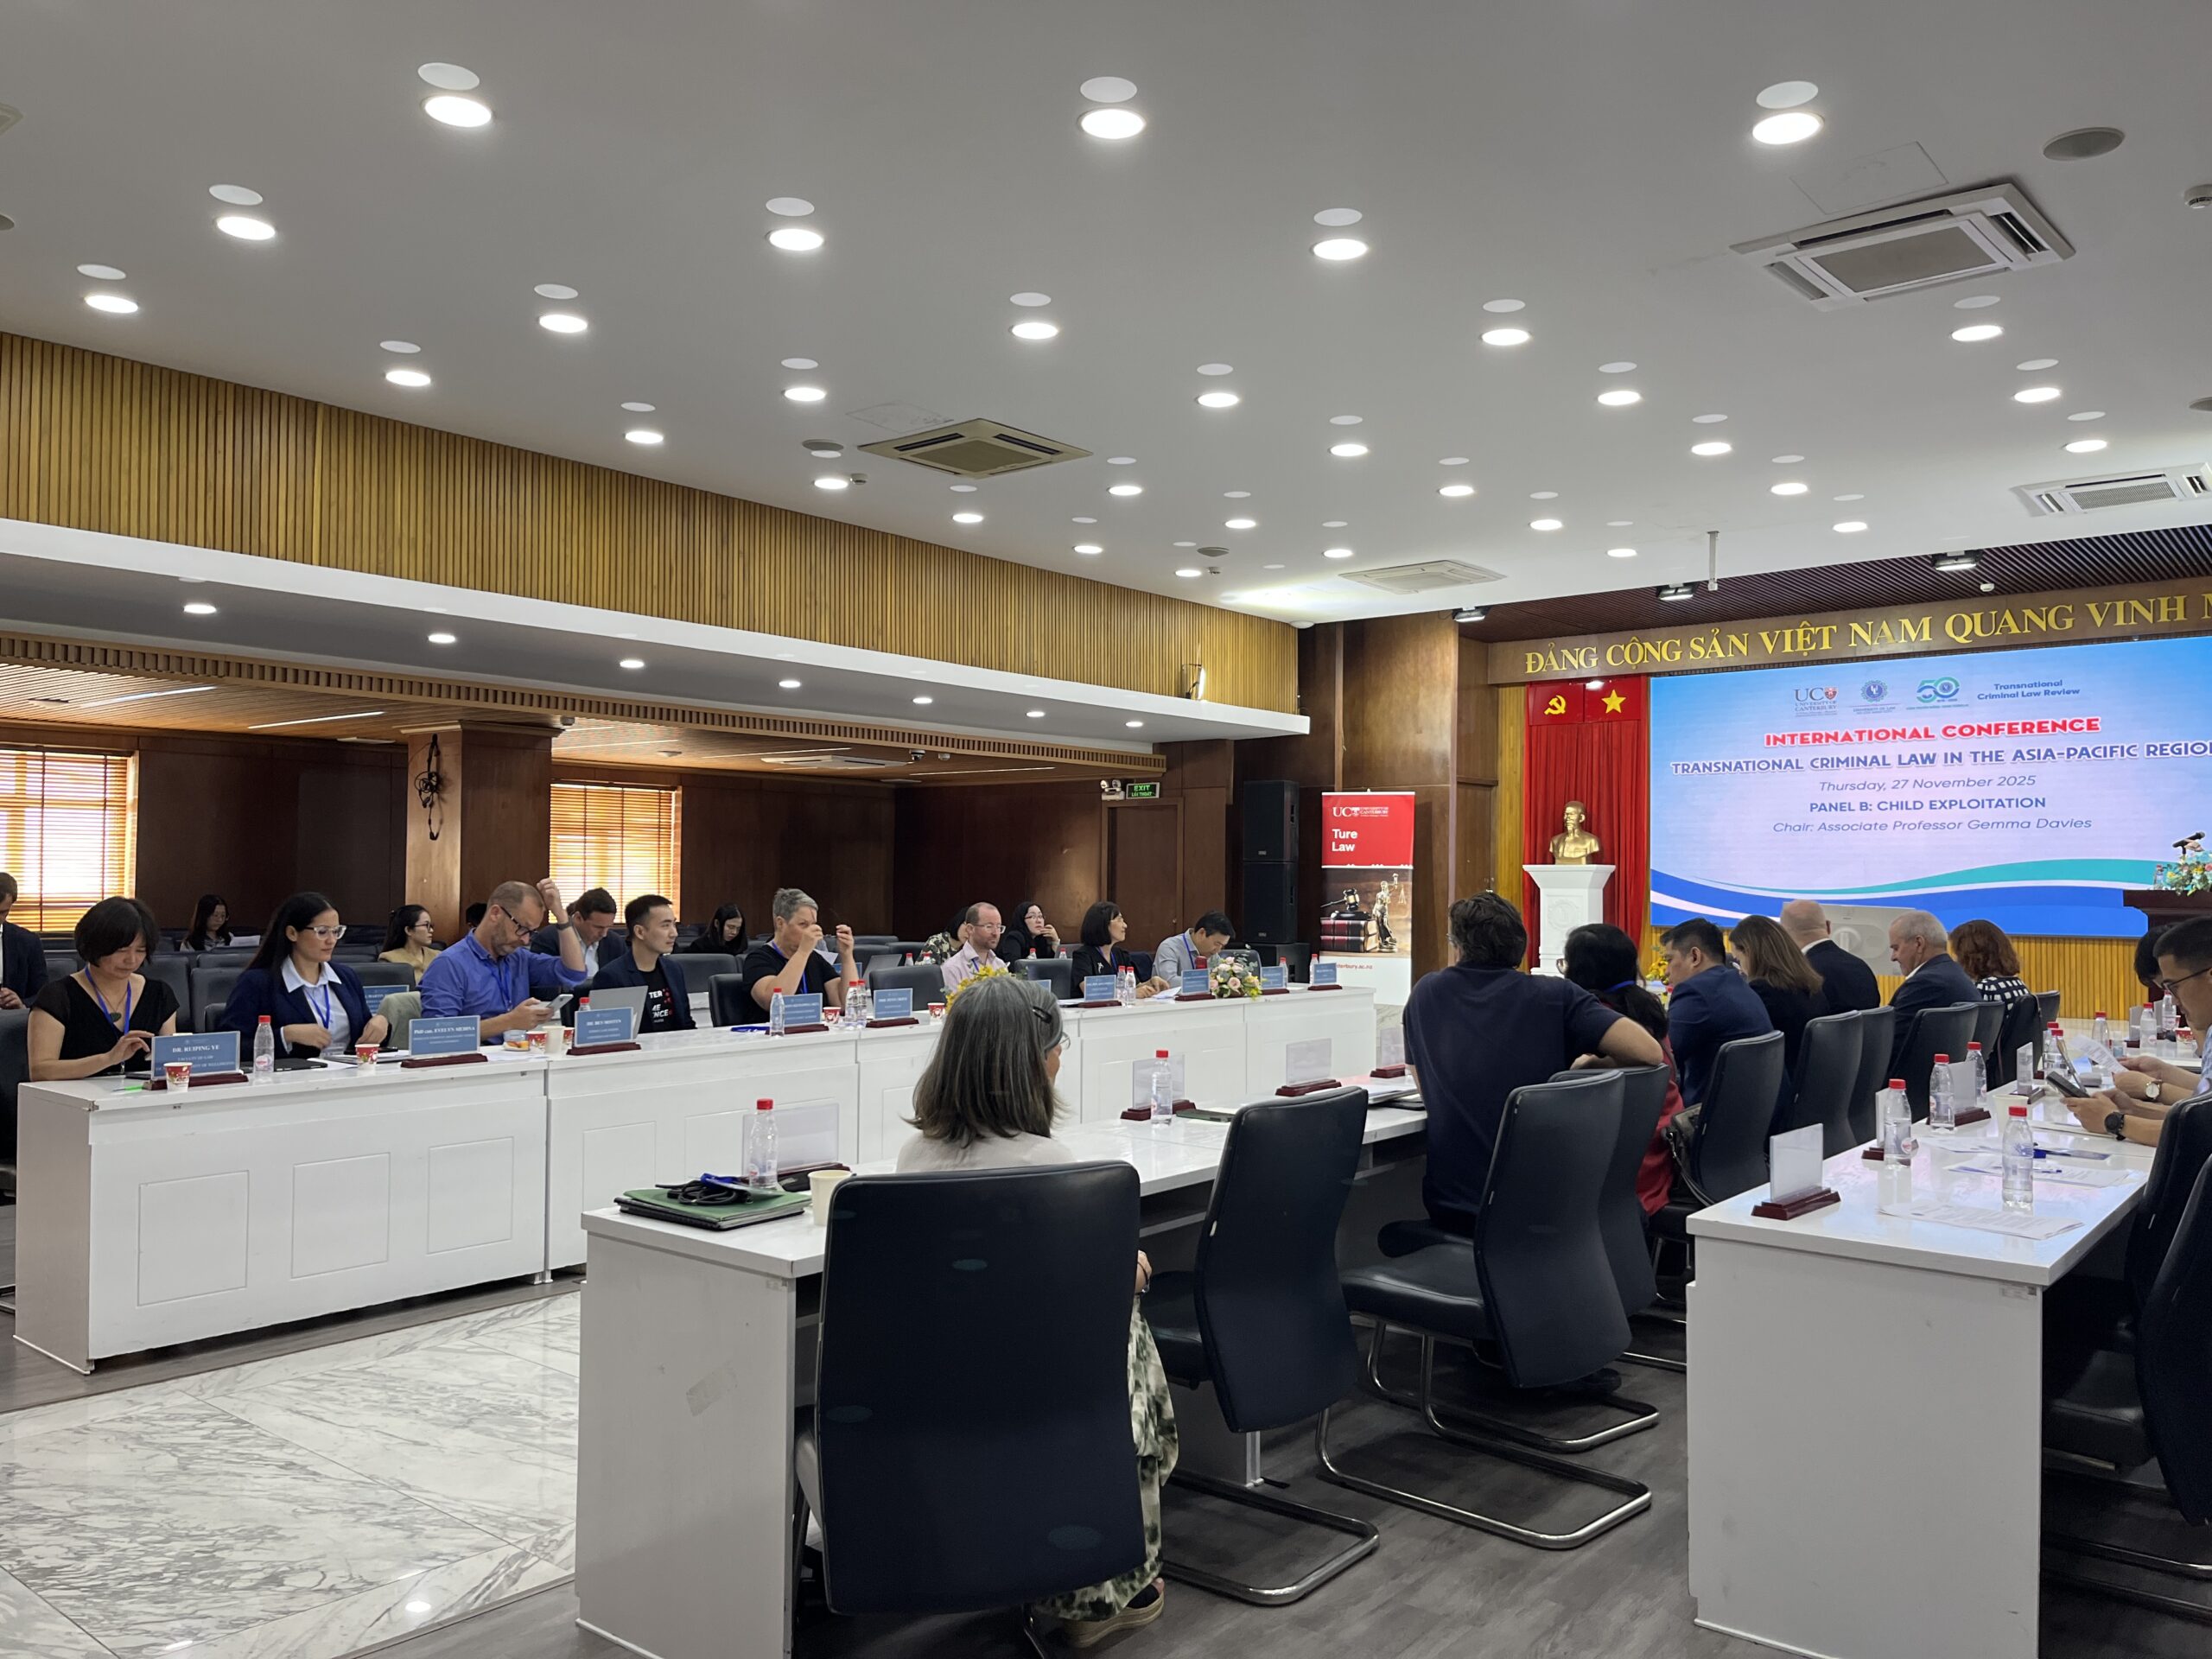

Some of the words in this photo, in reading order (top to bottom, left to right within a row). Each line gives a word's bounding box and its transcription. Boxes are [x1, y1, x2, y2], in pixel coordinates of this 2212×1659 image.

[1525, 643, 1599, 674] ĐẢNG
[1605, 636, 1682, 670] CỘNG
[1689, 627, 1750, 660] SẢN
[1758, 620, 1837, 657] VIỆT
[1847, 616, 1933, 647] NAM
[1944, 604, 2075, 644] QUANG
[2085, 595, 2189, 628] VINH
[1993, 680, 2063, 690] Transnational
[1793, 687, 1824, 702] UC
[1977, 691, 2018, 700] Criminal
[1765, 726, 1935, 746] INTERNATIONAL
[1942, 717, 2101, 737] CONFERENCE
[1672, 758, 1803, 774] TRANSNATIONAL
[1809, 754, 1890, 769] CRIMINAL
[1897, 753, 1936, 766] LAW
[1944, 752, 1962, 764] IN
[1970, 750, 2005, 763] THE
[2012, 744, 2138, 762] ASIA-PACIFIC
[2145, 741, 2212, 757] REGIO
[1820, 781, 1887, 791] Thursday,
[1891, 779, 1909, 790] 27
[1912, 777, 1993, 789] November
[1997, 775, 2037, 787] 2025
[1332, 806, 1352, 817] UC
[1809, 802, 1856, 812] PANEL
[1859, 801, 1872, 811] B:
[1877, 800, 1923, 810] CHILD
[1929, 798, 2046, 810] EXPLOITATION
[1773, 823, 1814, 833] Chair:
[1817, 821, 1888, 832] Associate
[1892, 819, 1962, 831] Professor
[1967, 819, 2031, 830] Gemma
[2036, 817, 2092, 830] Davies
[1332, 829, 1357, 839] Ture
[1332, 842, 1355, 852] Law
